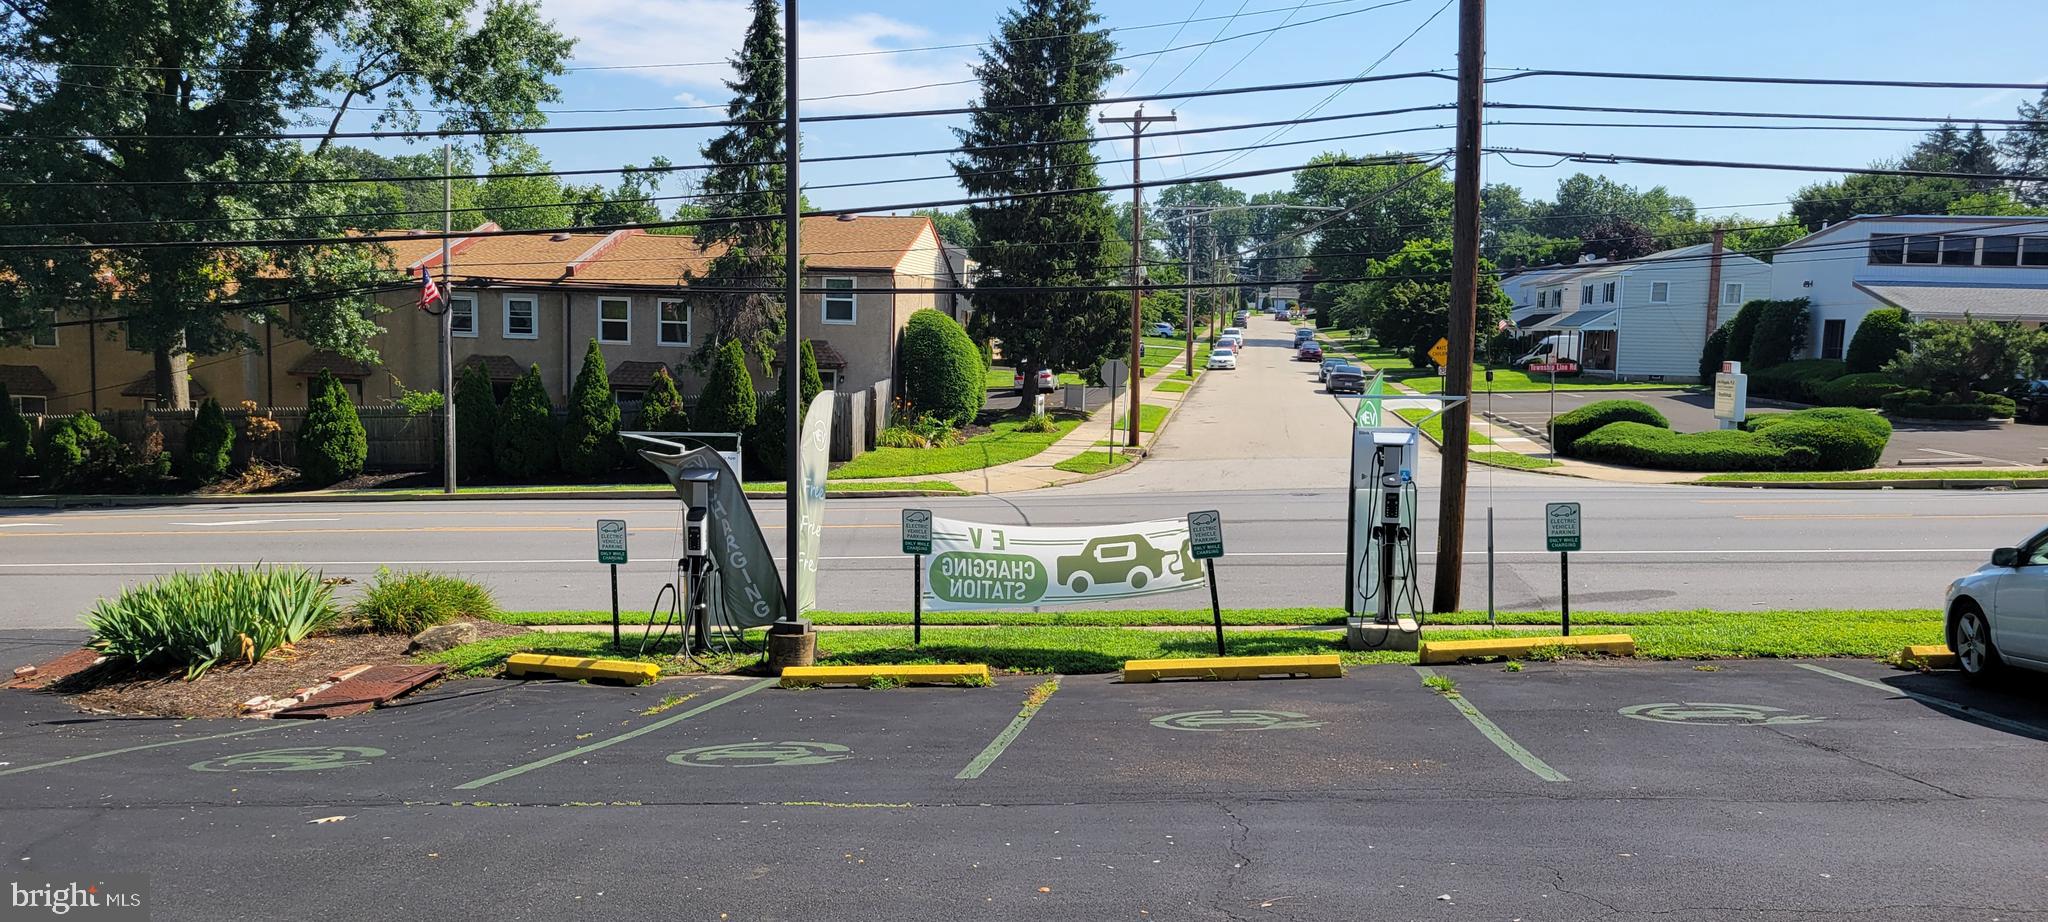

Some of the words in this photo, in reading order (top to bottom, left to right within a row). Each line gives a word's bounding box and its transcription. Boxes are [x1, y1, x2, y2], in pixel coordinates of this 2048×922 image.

[1530, 363, 1555, 372] Township
[1556, 363, 1569, 371] Line
[1570, 363, 1577, 371] Rd
[803, 477, 825, 500] Free
[800, 514, 821, 537] Free
